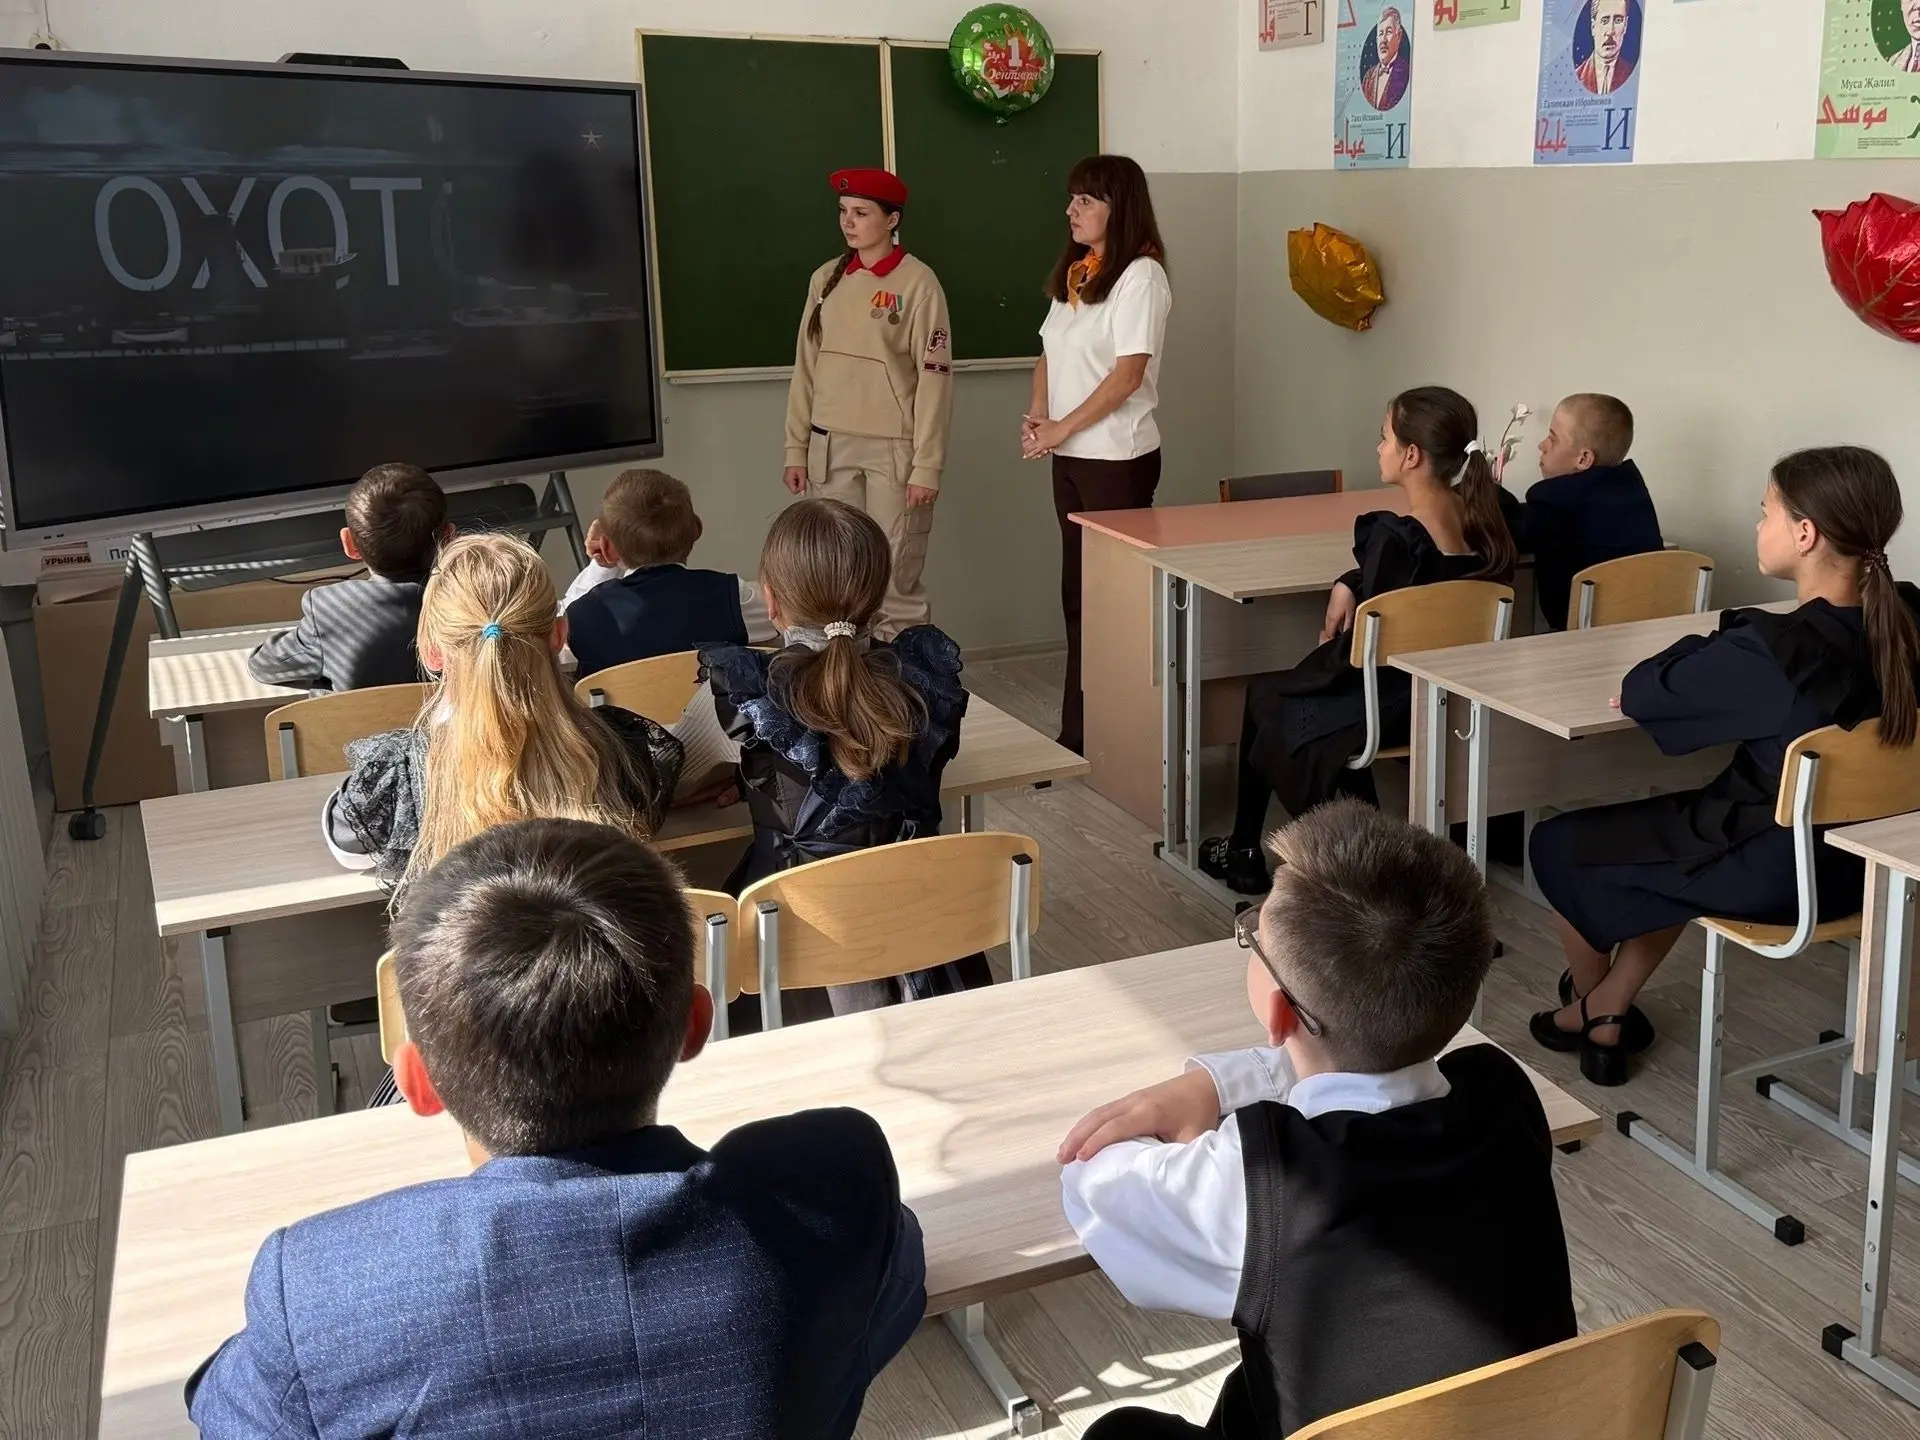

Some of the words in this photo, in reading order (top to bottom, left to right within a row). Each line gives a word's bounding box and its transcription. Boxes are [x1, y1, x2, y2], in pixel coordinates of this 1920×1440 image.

[1008, 37, 1023, 67] 1
[1840, 78, 1863, 91] Муса
[1385, 123, 1407, 159] И
[1601, 107, 1633, 151] И
